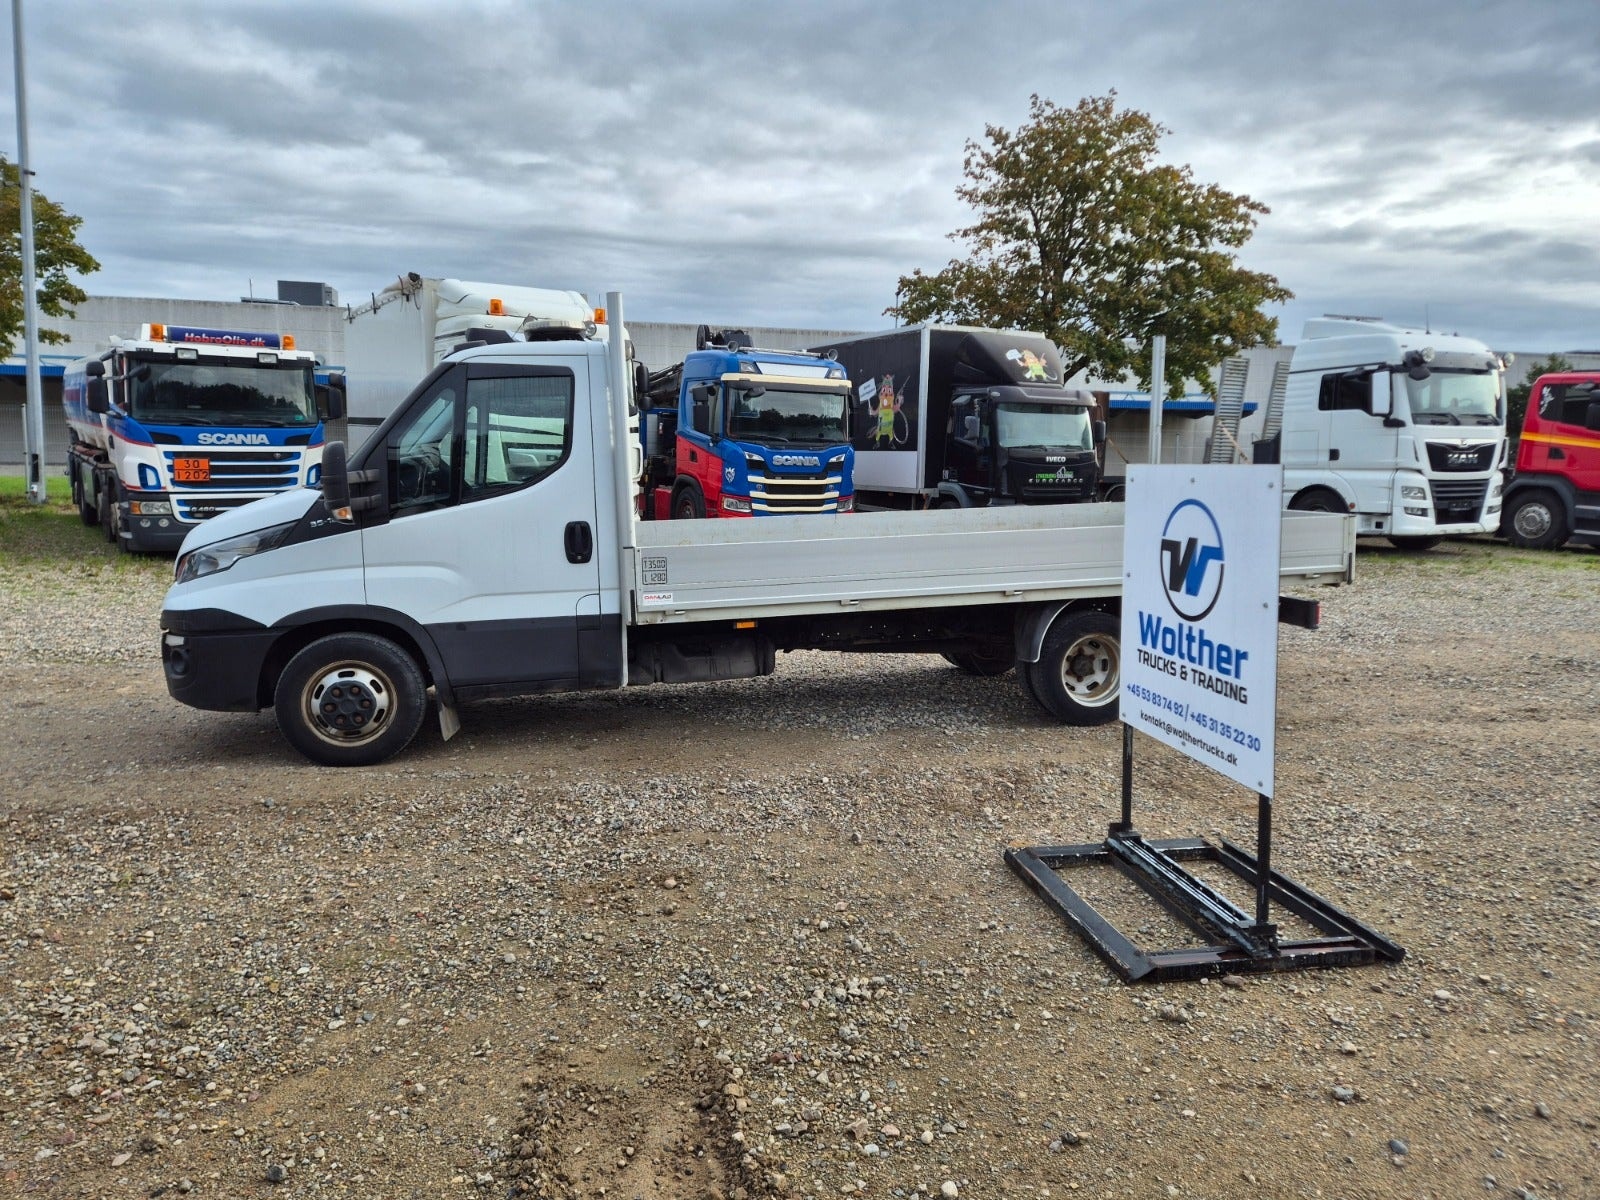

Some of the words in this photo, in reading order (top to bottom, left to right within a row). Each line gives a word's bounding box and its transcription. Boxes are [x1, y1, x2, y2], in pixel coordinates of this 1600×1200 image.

[185, 332, 265, 347] HobroOlie.dk
[198, 433, 270, 445] SCANIA
[184, 459, 200, 469] 30
[772, 455, 820, 467] SCANIA
[177, 471, 209, 480] 1202
[1138, 610, 1249, 680] Wolther
[1137, 648, 1177, 677] TRUCKS
[1180, 665, 1188, 681] &
[1191, 669, 1248, 705] TRADING
[1127, 683, 1141, 697] +45
[1190, 711, 1208, 728] +45
[1140, 709, 1238, 766] kontakt@wolthertrucks.dk
